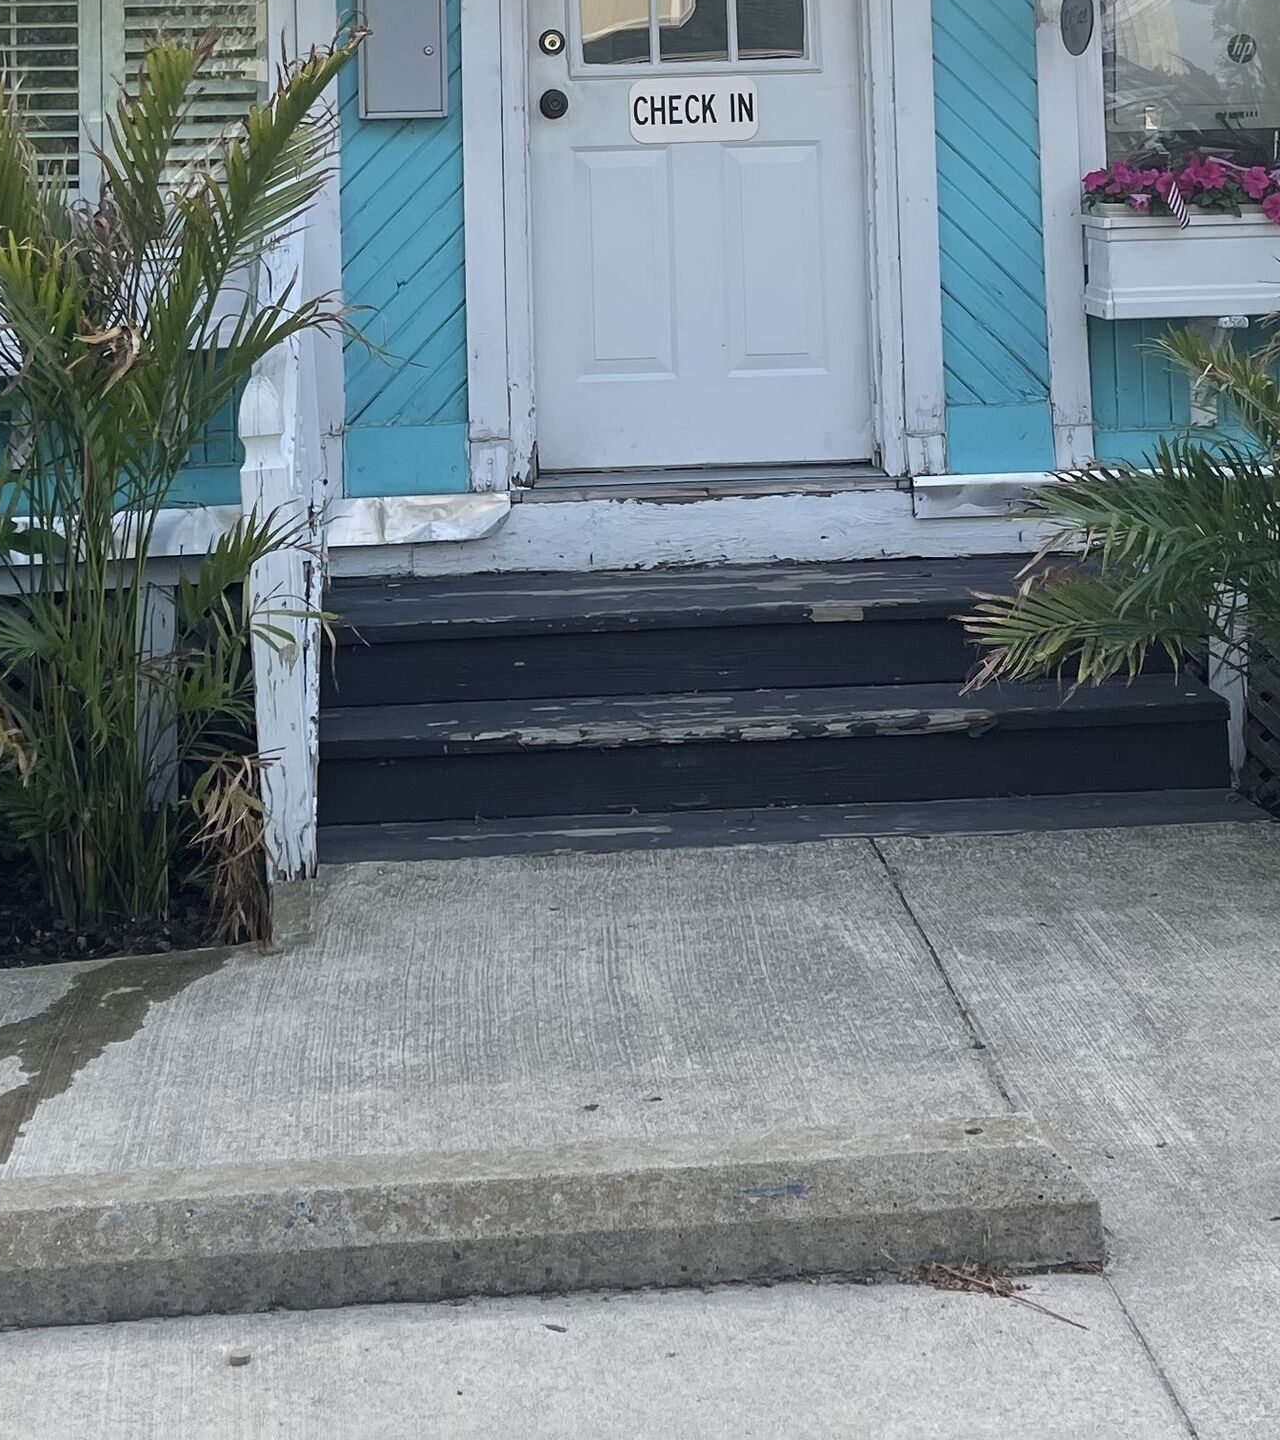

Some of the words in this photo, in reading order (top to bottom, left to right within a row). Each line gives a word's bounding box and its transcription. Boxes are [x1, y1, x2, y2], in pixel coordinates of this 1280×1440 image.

[1229, 33, 1255, 64] hp
[633, 93, 718, 126] CHECK
[729, 92, 754, 123] IN
